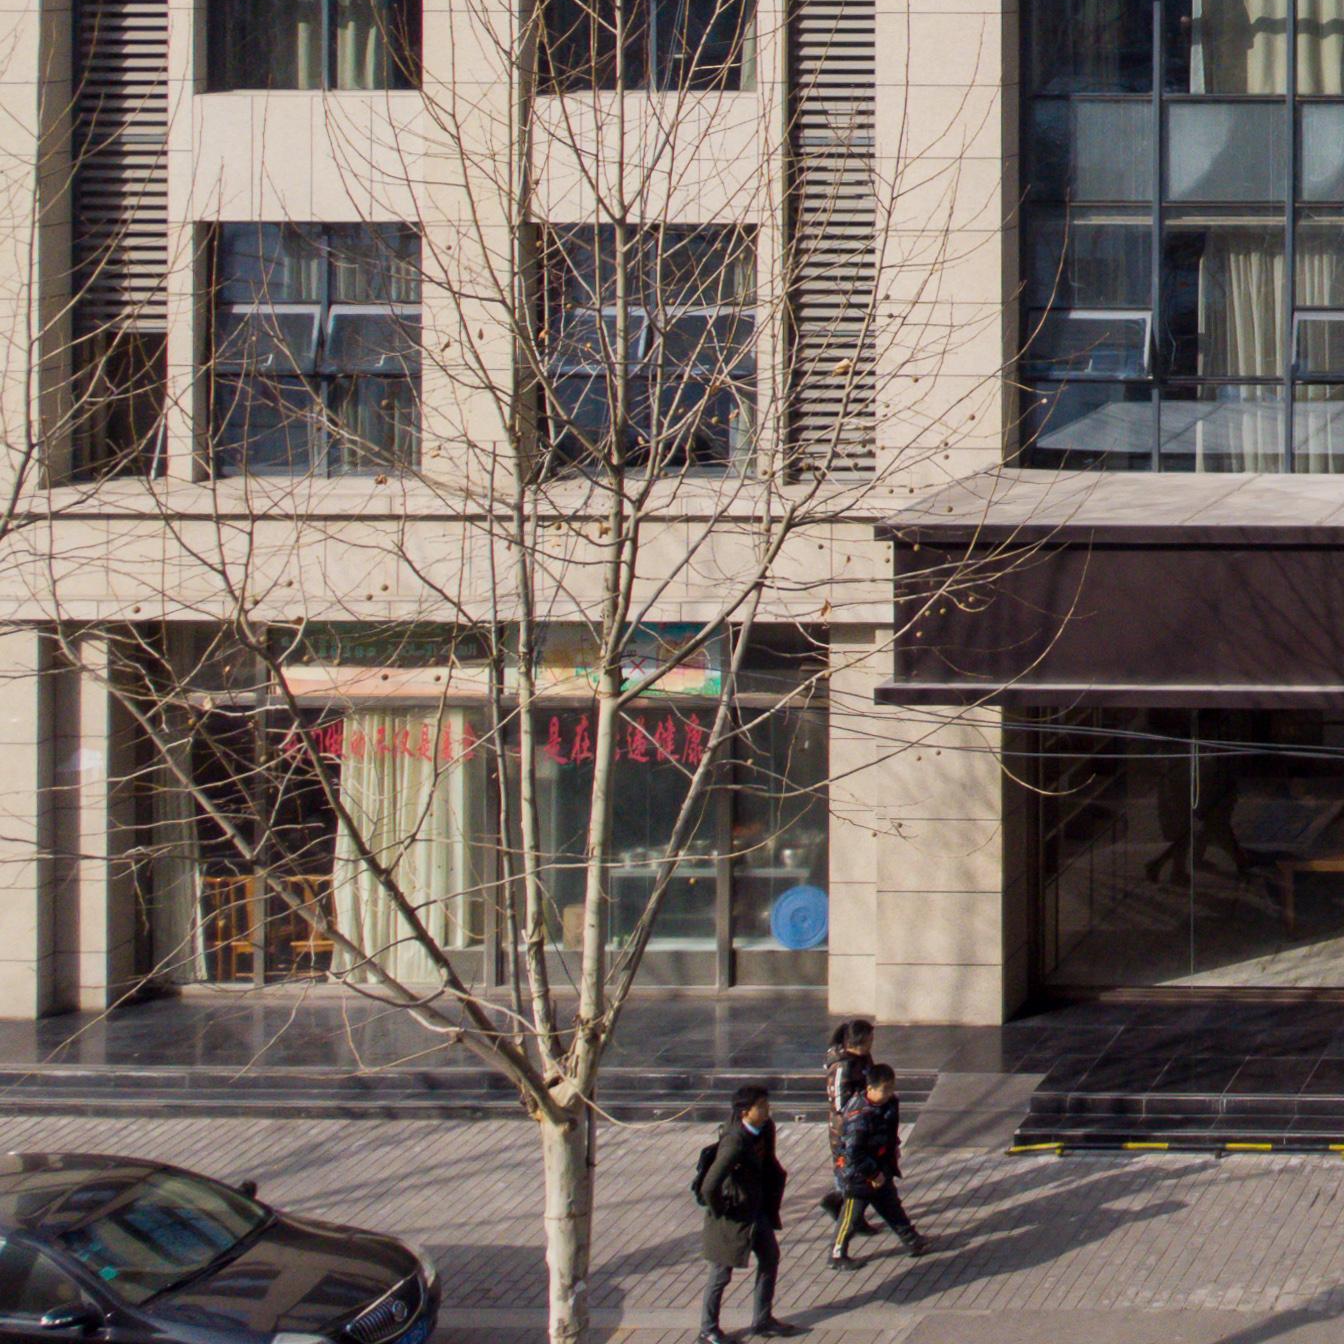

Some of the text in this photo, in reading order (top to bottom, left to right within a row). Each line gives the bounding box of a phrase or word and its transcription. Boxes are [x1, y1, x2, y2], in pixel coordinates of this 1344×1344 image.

[512, 713, 706, 766] 是在递健康
